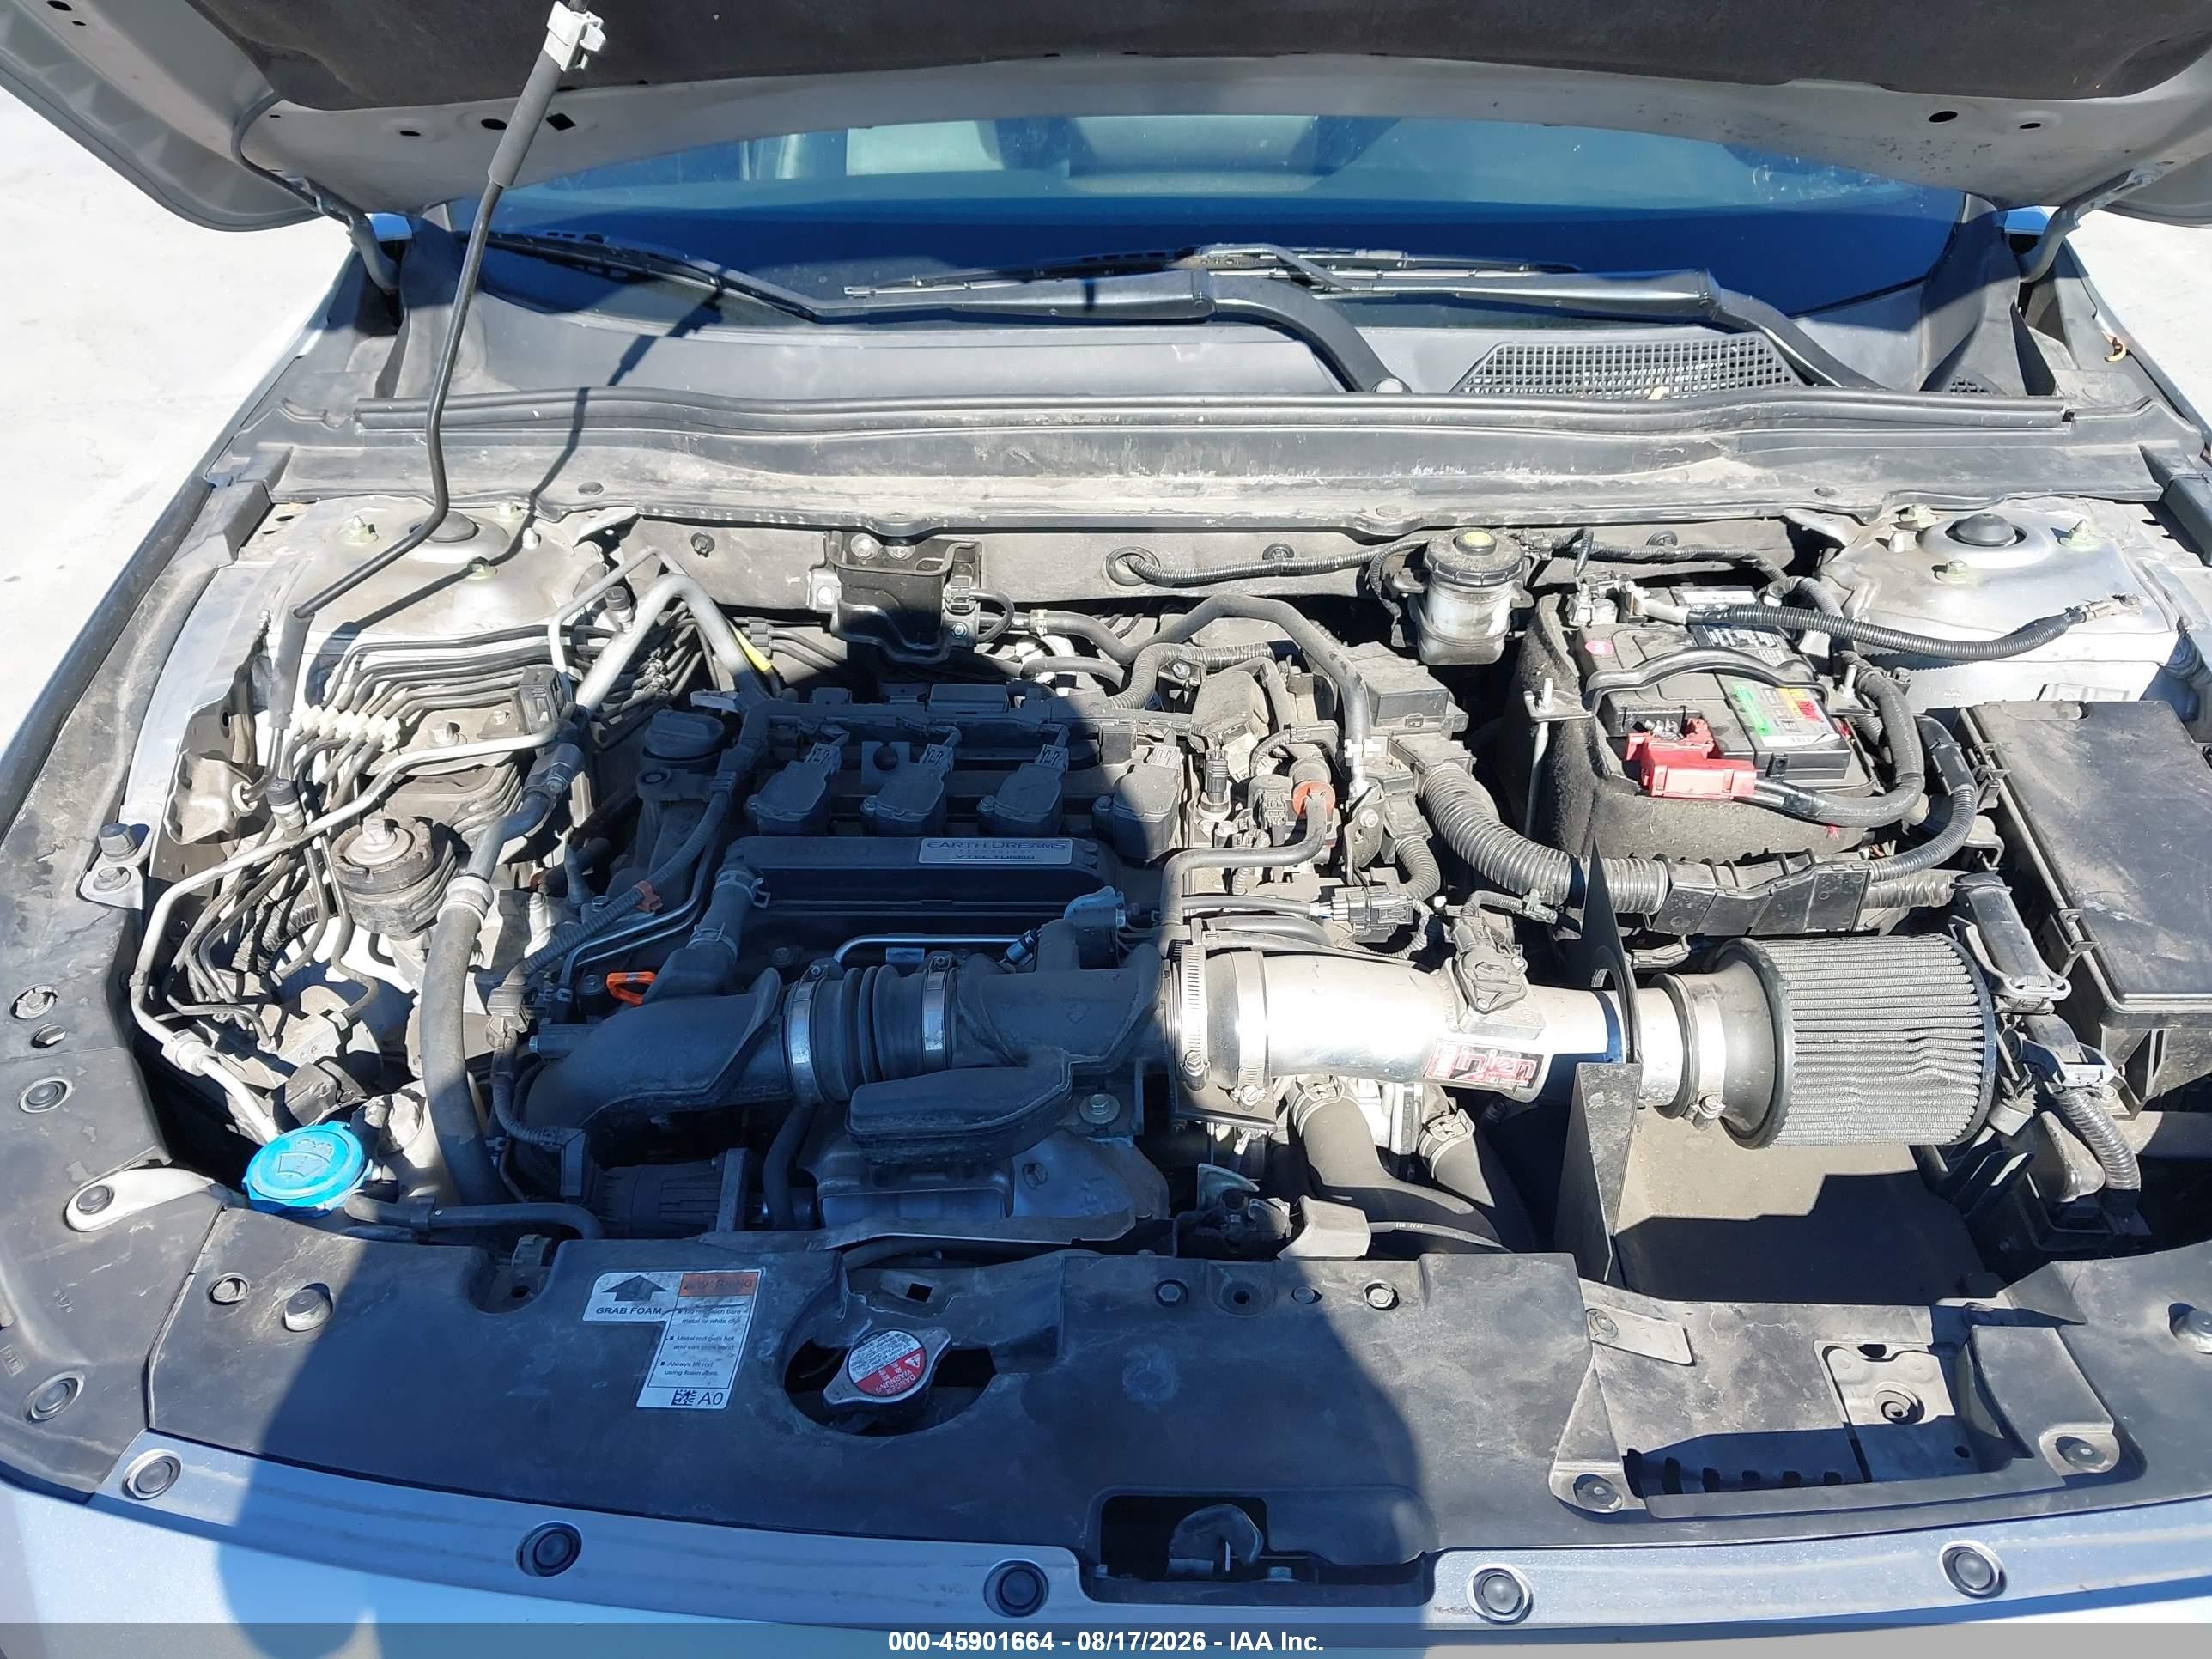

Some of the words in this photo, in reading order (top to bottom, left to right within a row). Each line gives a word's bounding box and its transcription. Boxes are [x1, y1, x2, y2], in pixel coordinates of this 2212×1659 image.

[927, 841, 987, 849] EARTH
[991, 841, 1068, 850] DREAMS
[595, 1306, 628, 1316] GRAB
[629, 1306, 662, 1316] FOAM
[885, 1372, 916, 1395] DANGER
[697, 1391, 725, 1406] A0
